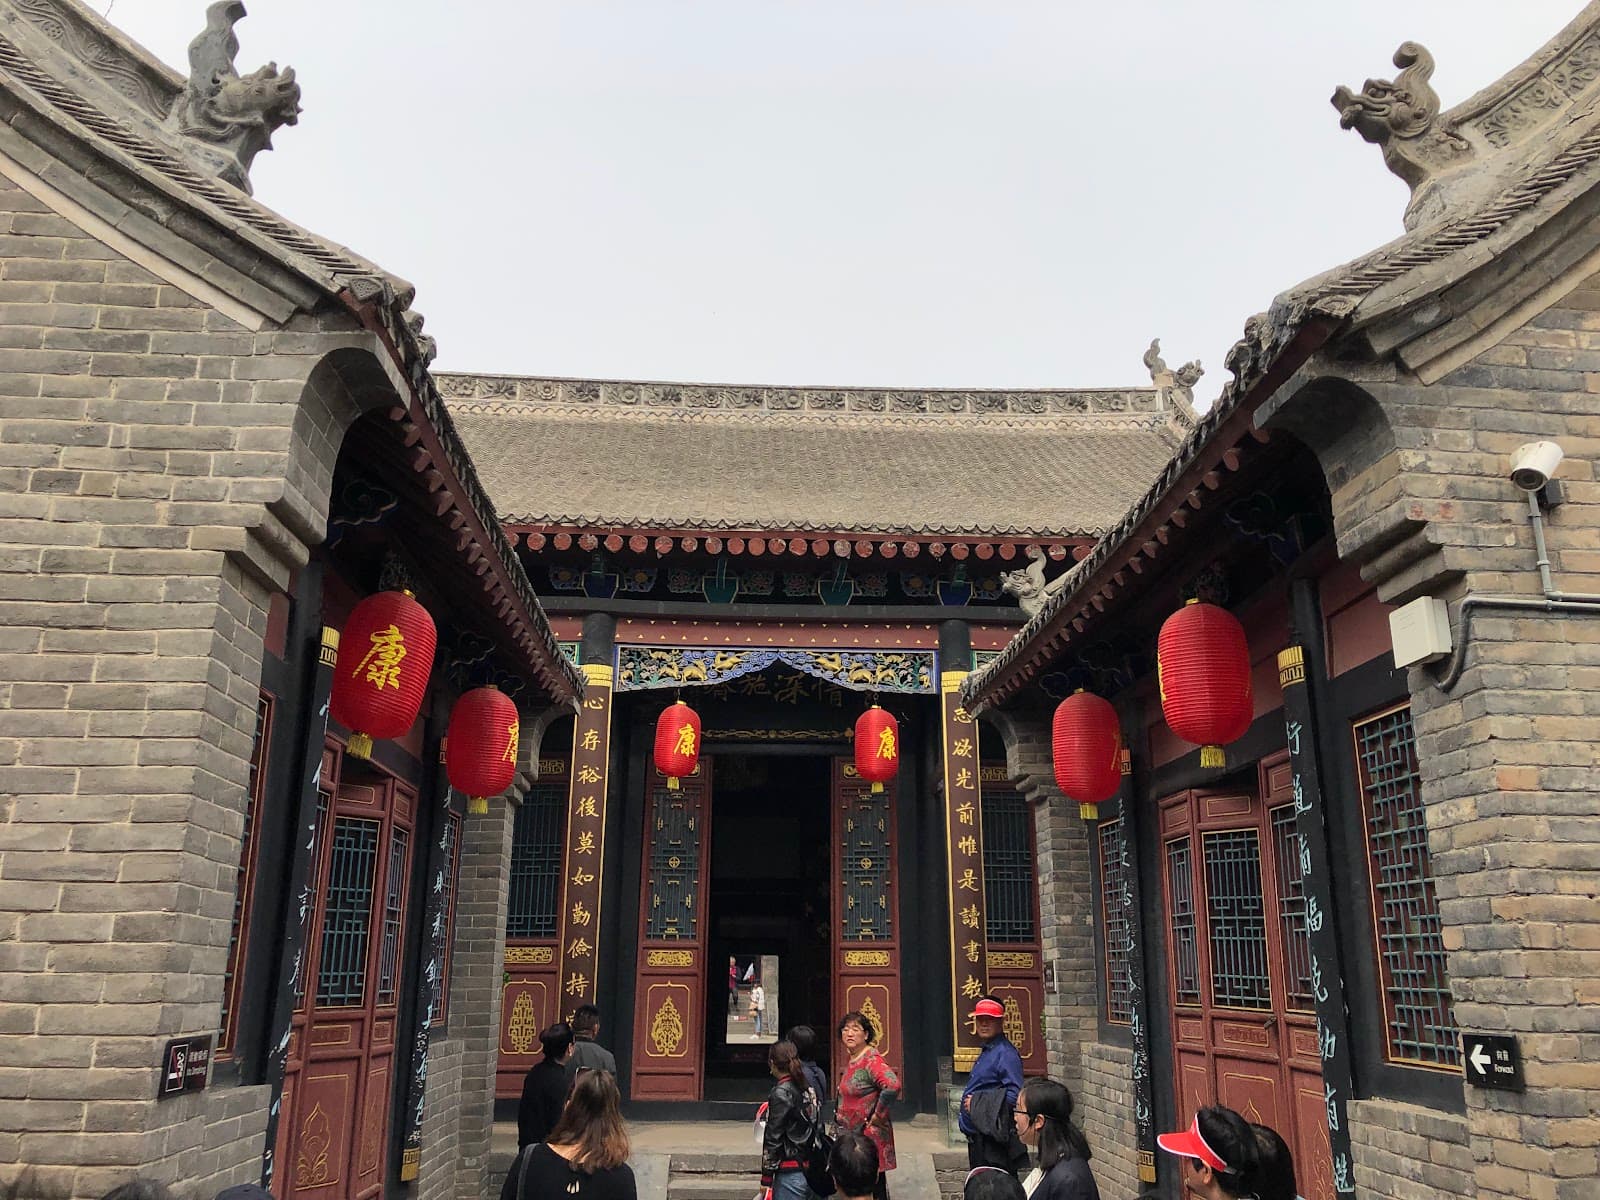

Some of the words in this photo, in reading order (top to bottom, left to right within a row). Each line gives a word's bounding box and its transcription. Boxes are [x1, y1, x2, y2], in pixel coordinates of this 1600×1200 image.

[352, 624, 407, 690] 康
[674, 724, 696, 757] 康
[877, 726, 896, 760] 康
